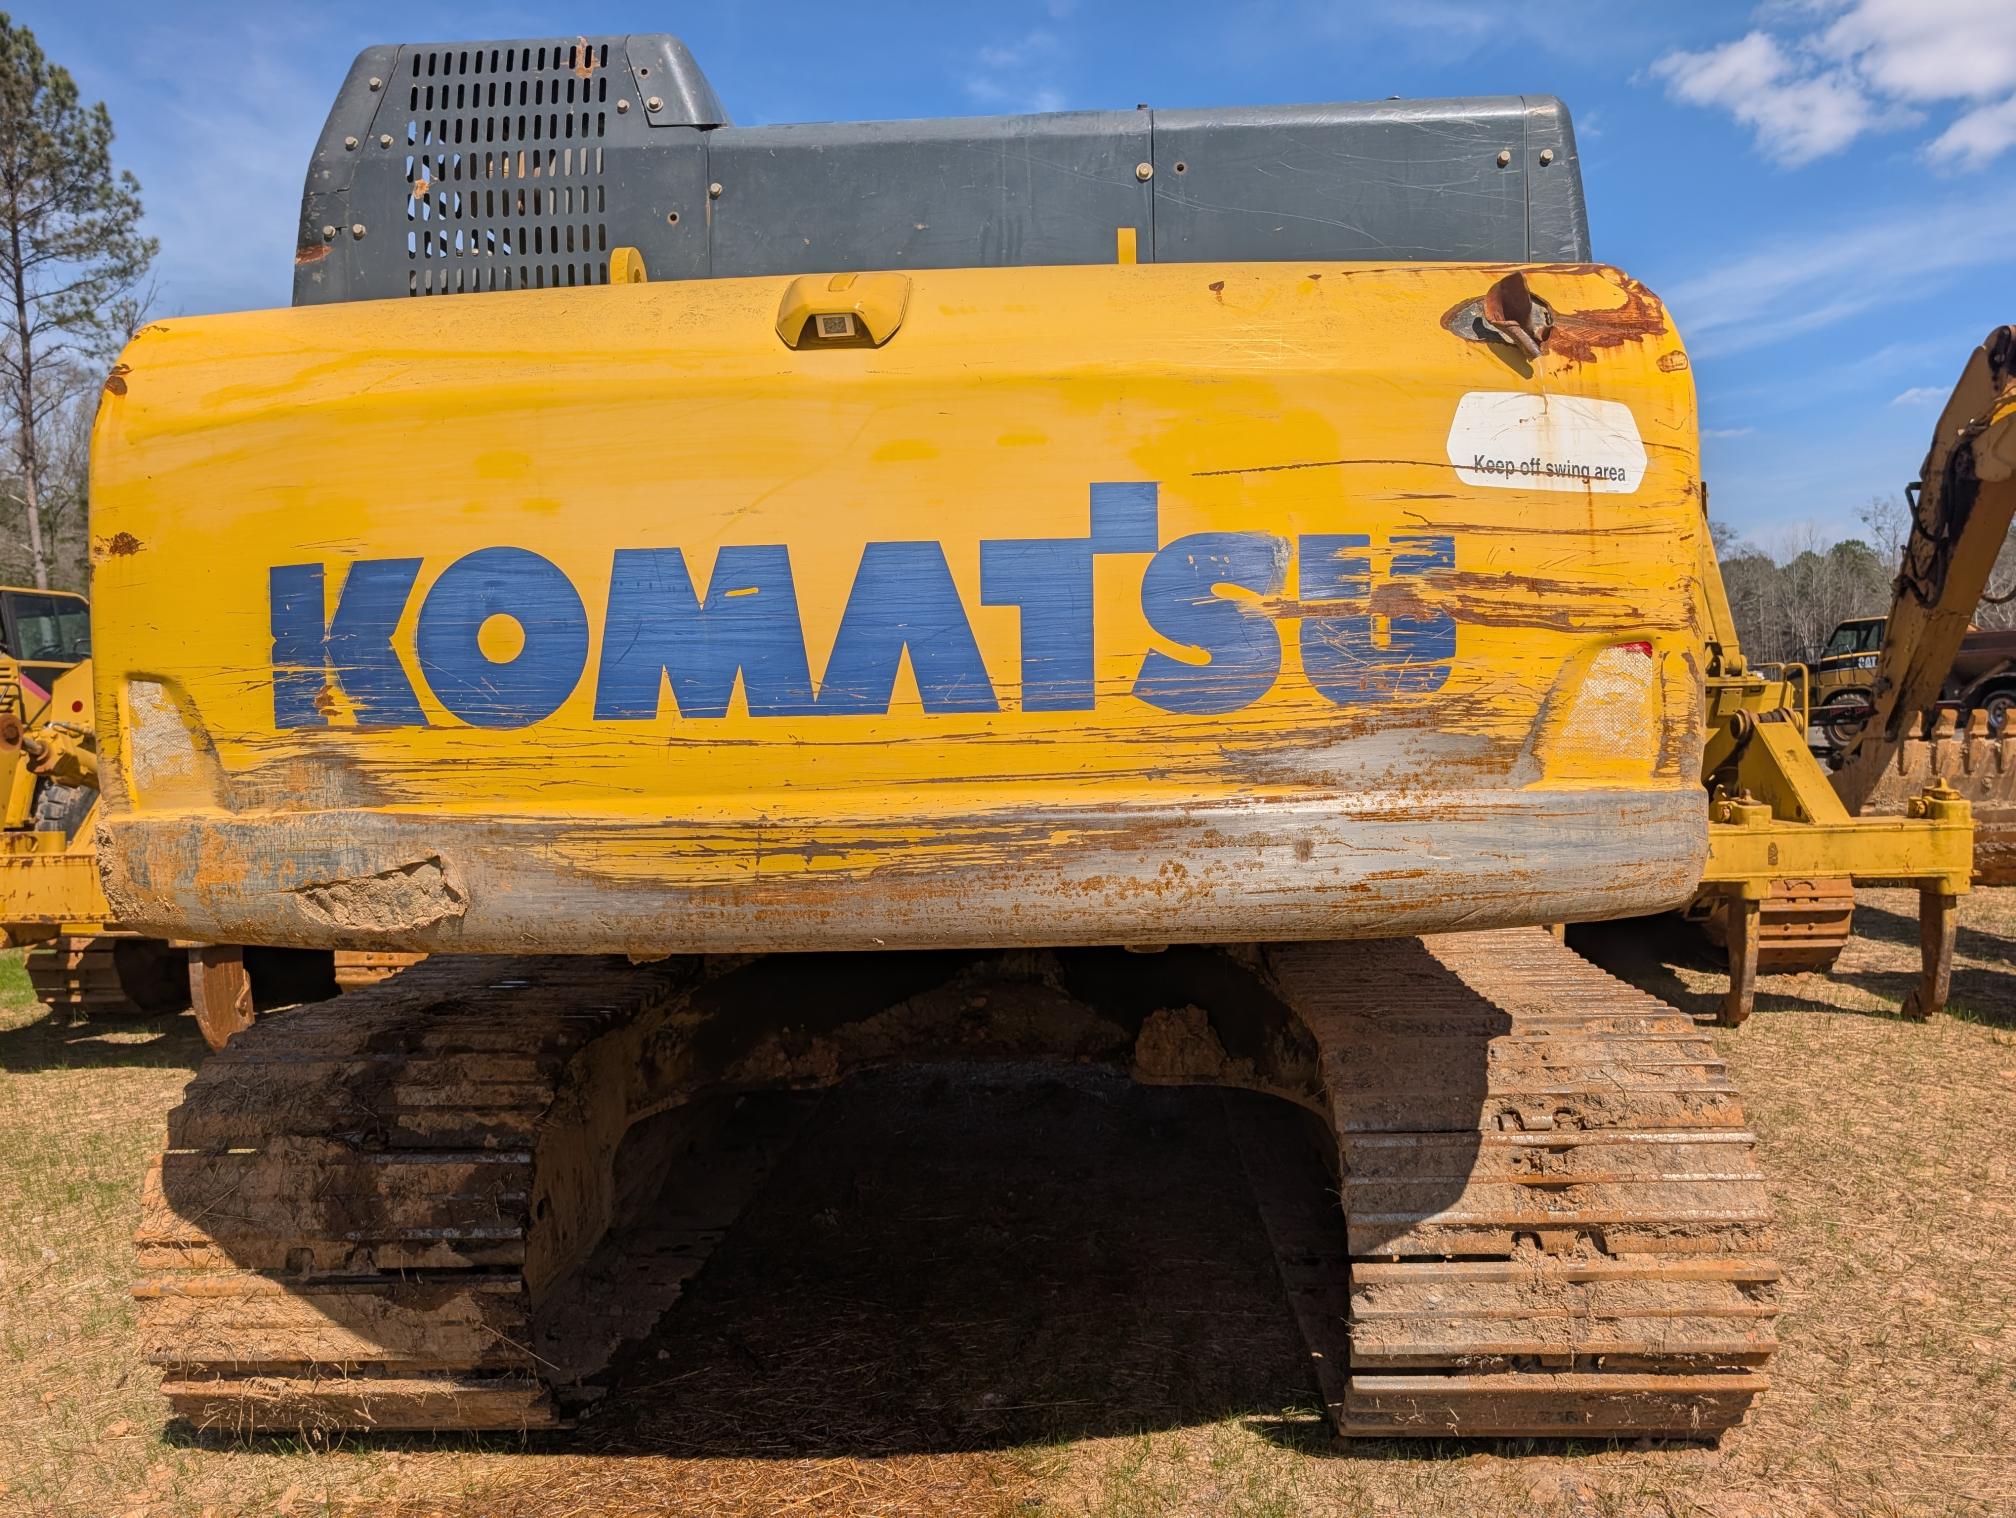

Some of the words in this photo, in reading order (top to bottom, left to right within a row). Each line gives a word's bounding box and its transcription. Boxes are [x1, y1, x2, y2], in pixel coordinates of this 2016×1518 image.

[1474, 454, 1515, 480] Keep
[1520, 457, 1541, 476] off
[1546, 460, 1590, 484] swing
[1595, 465, 1626, 482] area
[270, 482, 1457, 729] KOMATSU
[1858, 656, 1877, 668] CAT
